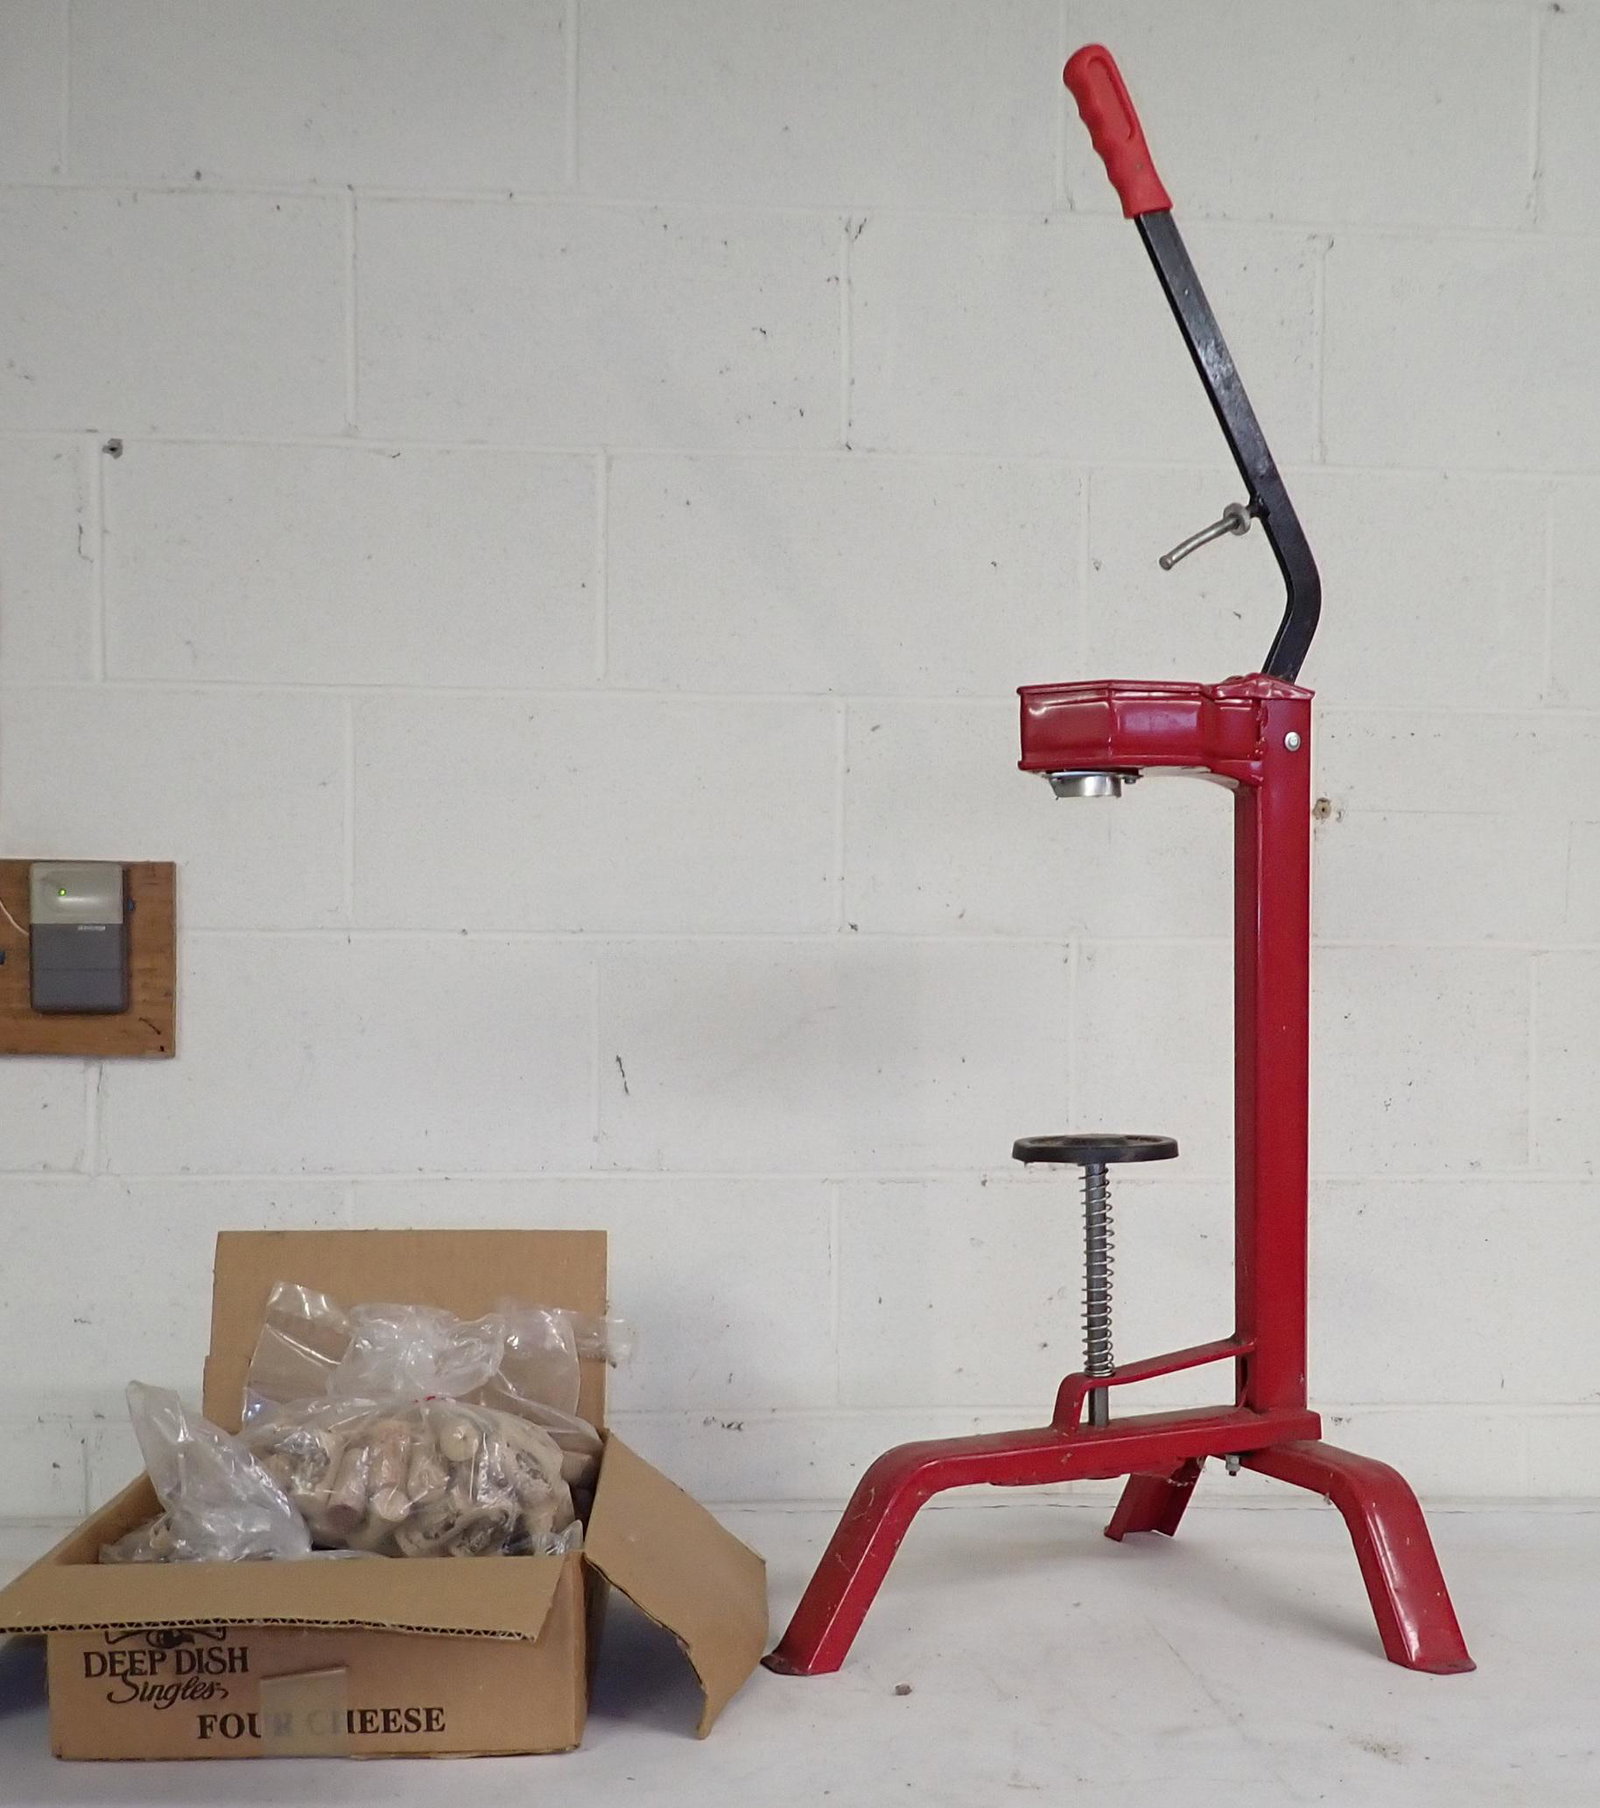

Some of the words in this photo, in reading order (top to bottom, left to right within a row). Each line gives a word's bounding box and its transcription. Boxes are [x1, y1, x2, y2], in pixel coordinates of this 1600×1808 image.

[84, 1650, 167, 1678] DEEP
[175, 1646, 249, 1675] DISH
[107, 1668, 229, 1710] Singles
